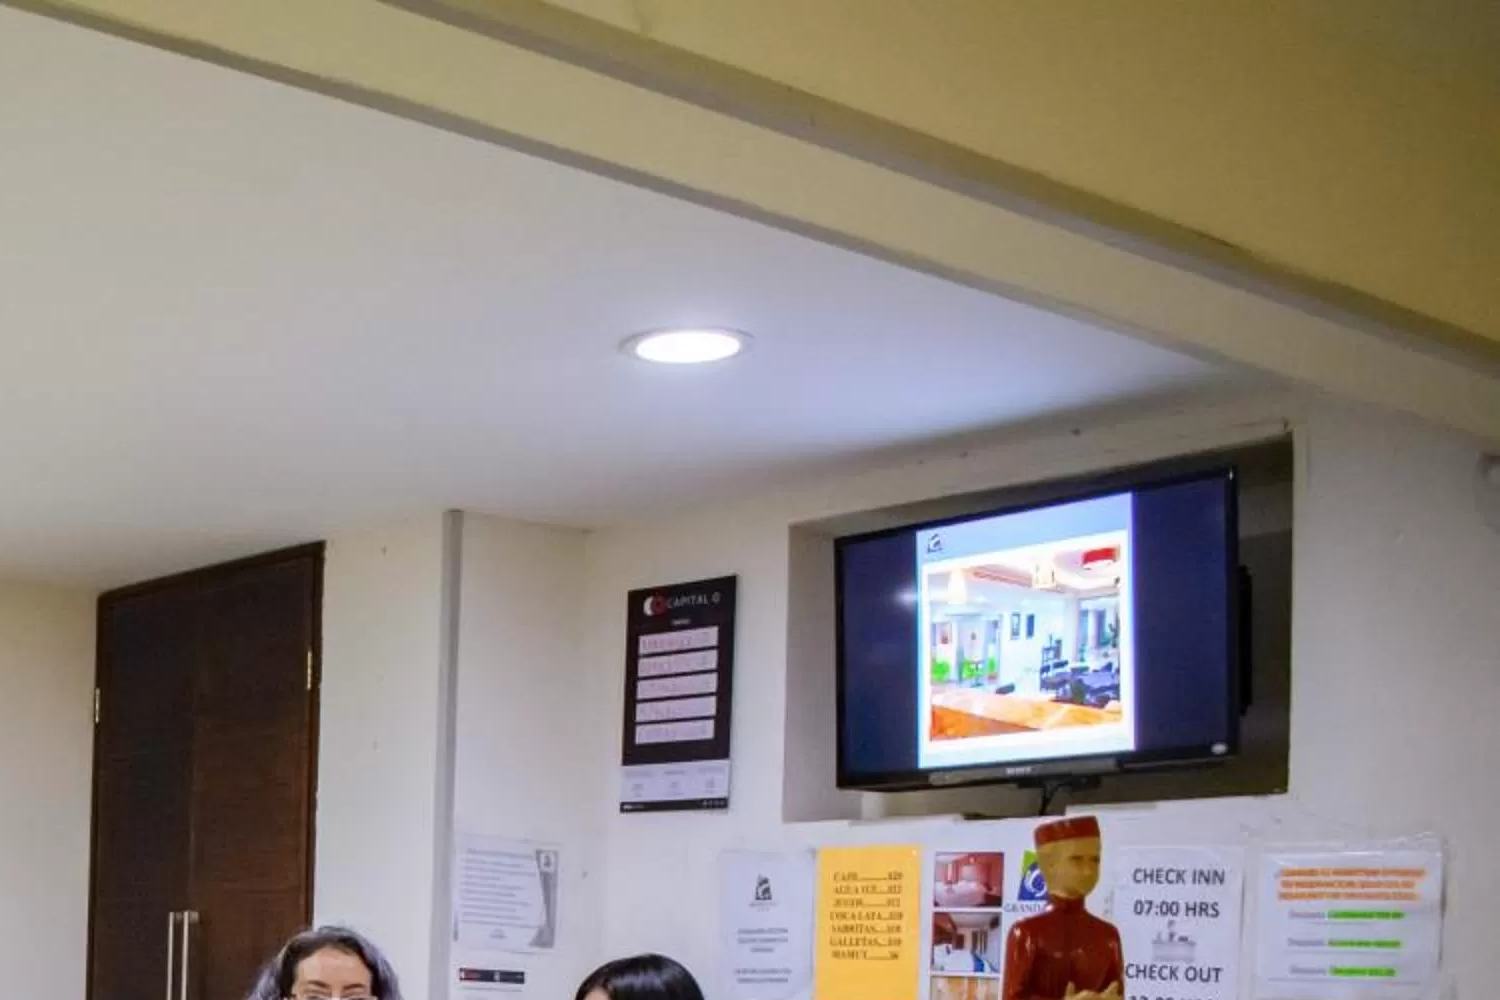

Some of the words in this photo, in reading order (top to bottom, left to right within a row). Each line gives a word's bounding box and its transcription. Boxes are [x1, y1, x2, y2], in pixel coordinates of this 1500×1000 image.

[667, 594, 708, 609] CAPITAL
[1132, 868, 1187, 885] CHECK
[1192, 869, 1226, 885] INN
[1133, 900, 1180, 917] 07:00
[1184, 901, 1220, 918] HRS
[1125, 963, 1179, 981] CHECK
[1184, 966, 1223, 983] OUT
